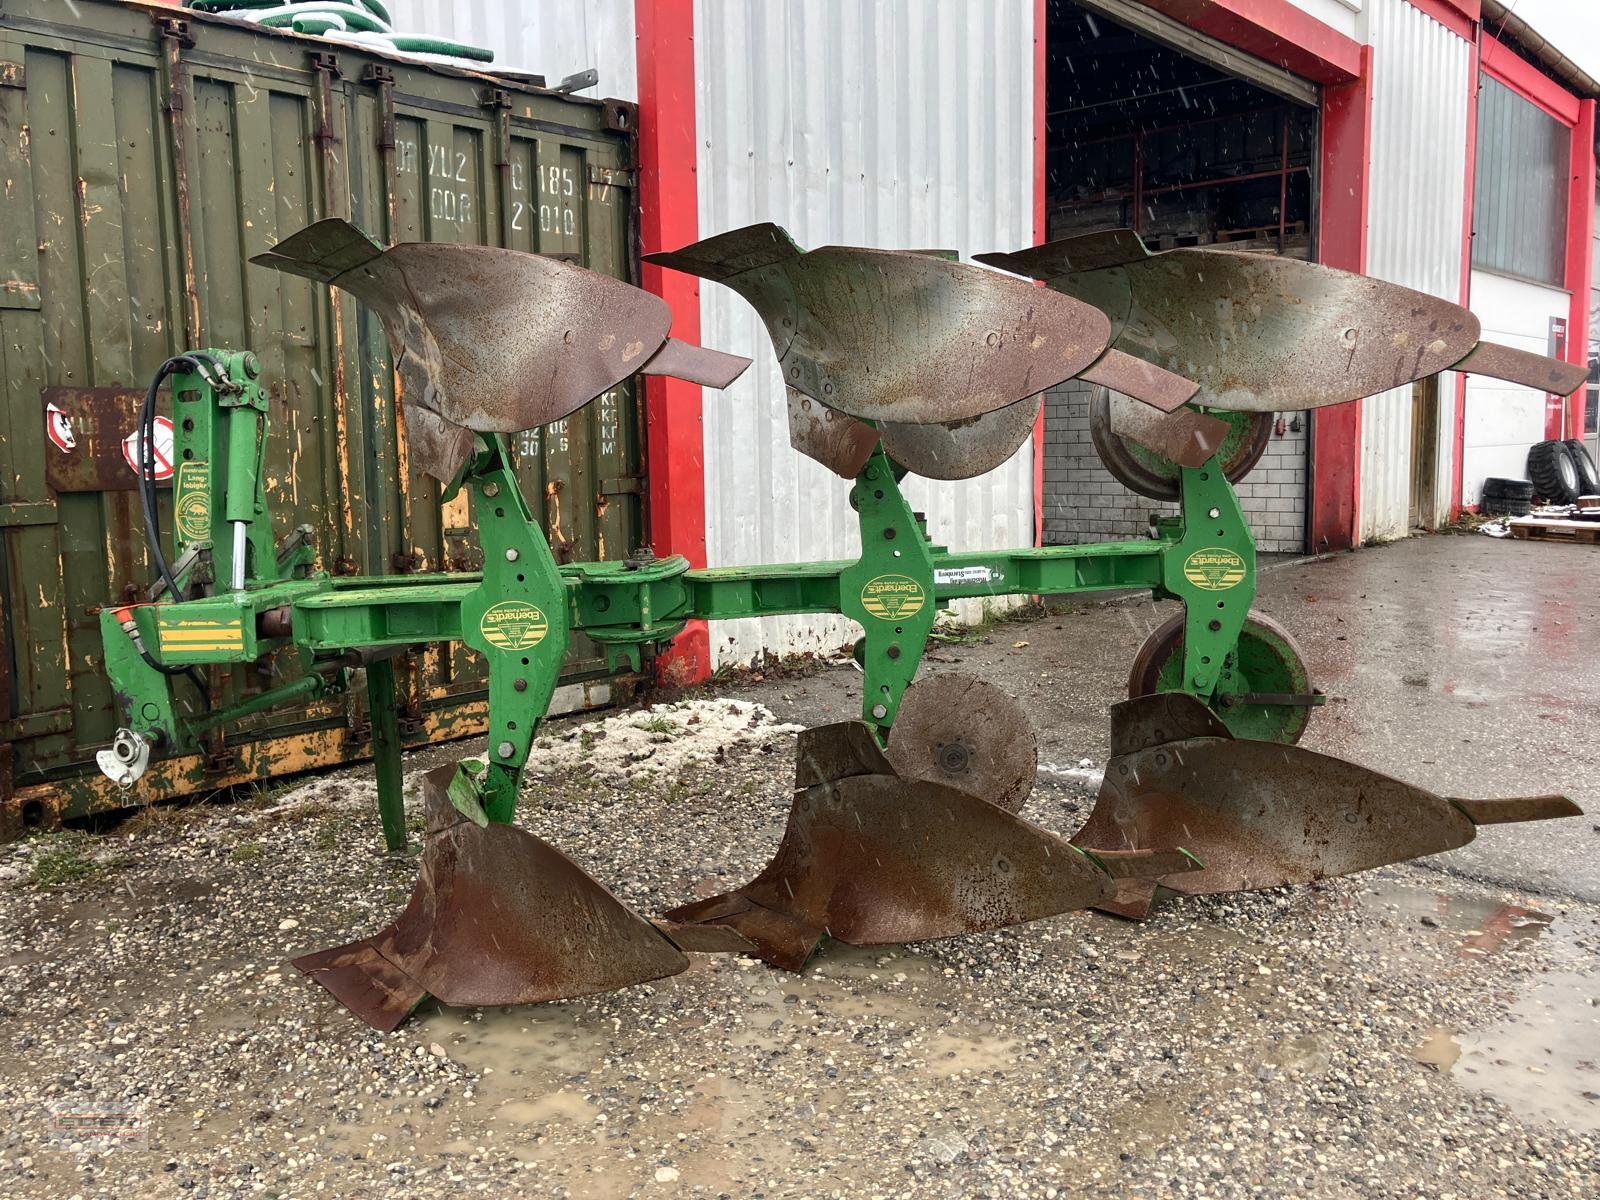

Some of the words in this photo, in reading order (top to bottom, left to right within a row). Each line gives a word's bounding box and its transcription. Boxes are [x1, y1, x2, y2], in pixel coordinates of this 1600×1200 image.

[540, 164, 573, 196] 185
[512, 201, 523, 230] 2
[540, 204, 573, 236] 010
[520, 441, 539, 456] 30
[876, 584, 918, 593] Eberhardt
[494, 611, 540, 622] Eberhardt
